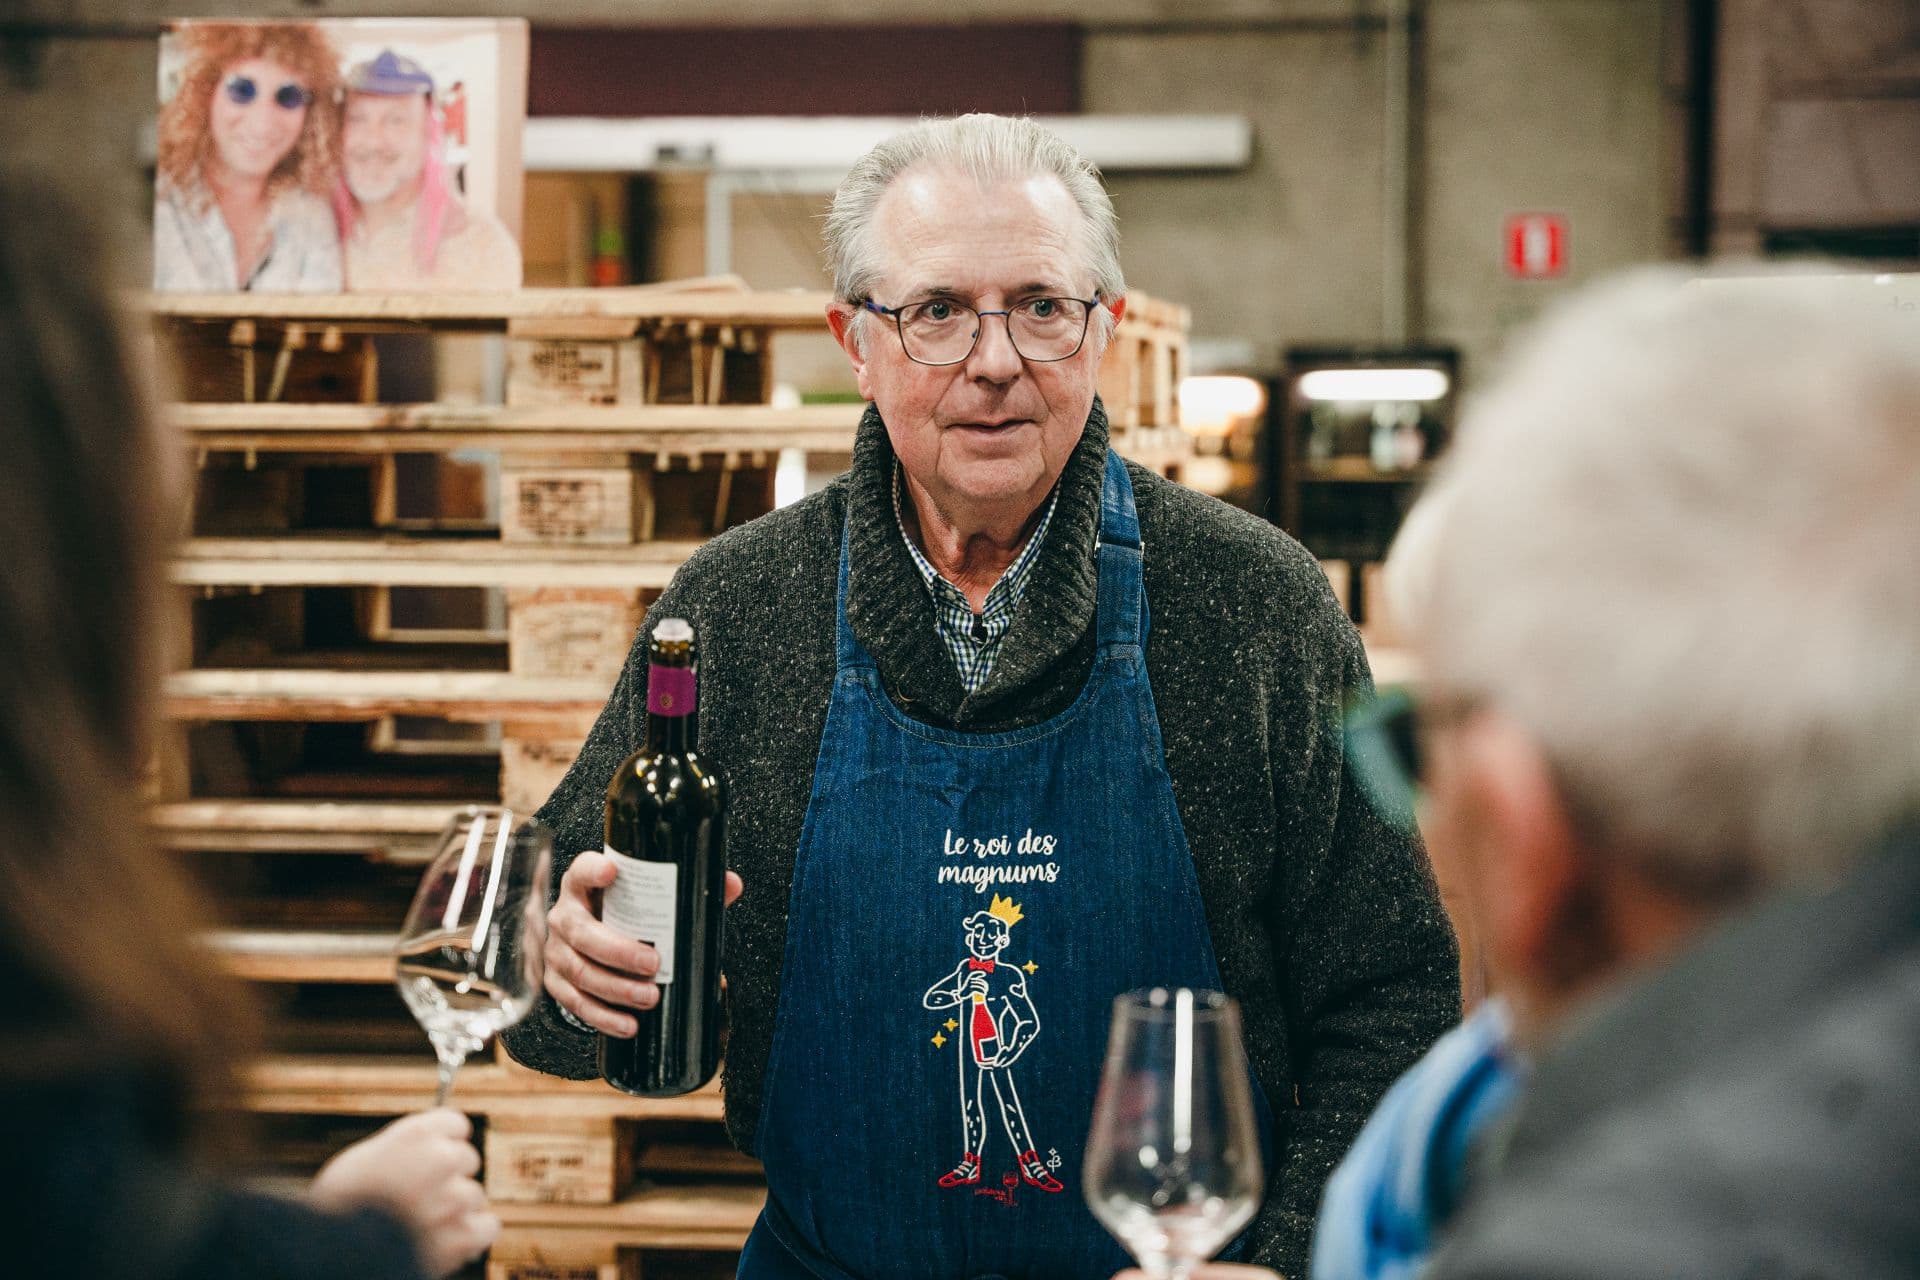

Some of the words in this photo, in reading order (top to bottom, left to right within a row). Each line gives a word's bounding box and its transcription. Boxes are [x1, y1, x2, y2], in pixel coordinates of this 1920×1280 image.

[944, 828, 970, 855] Le
[973, 834, 1012, 858] roi
[1017, 827, 1058, 855] des
[938, 862, 1060, 893] magnums
